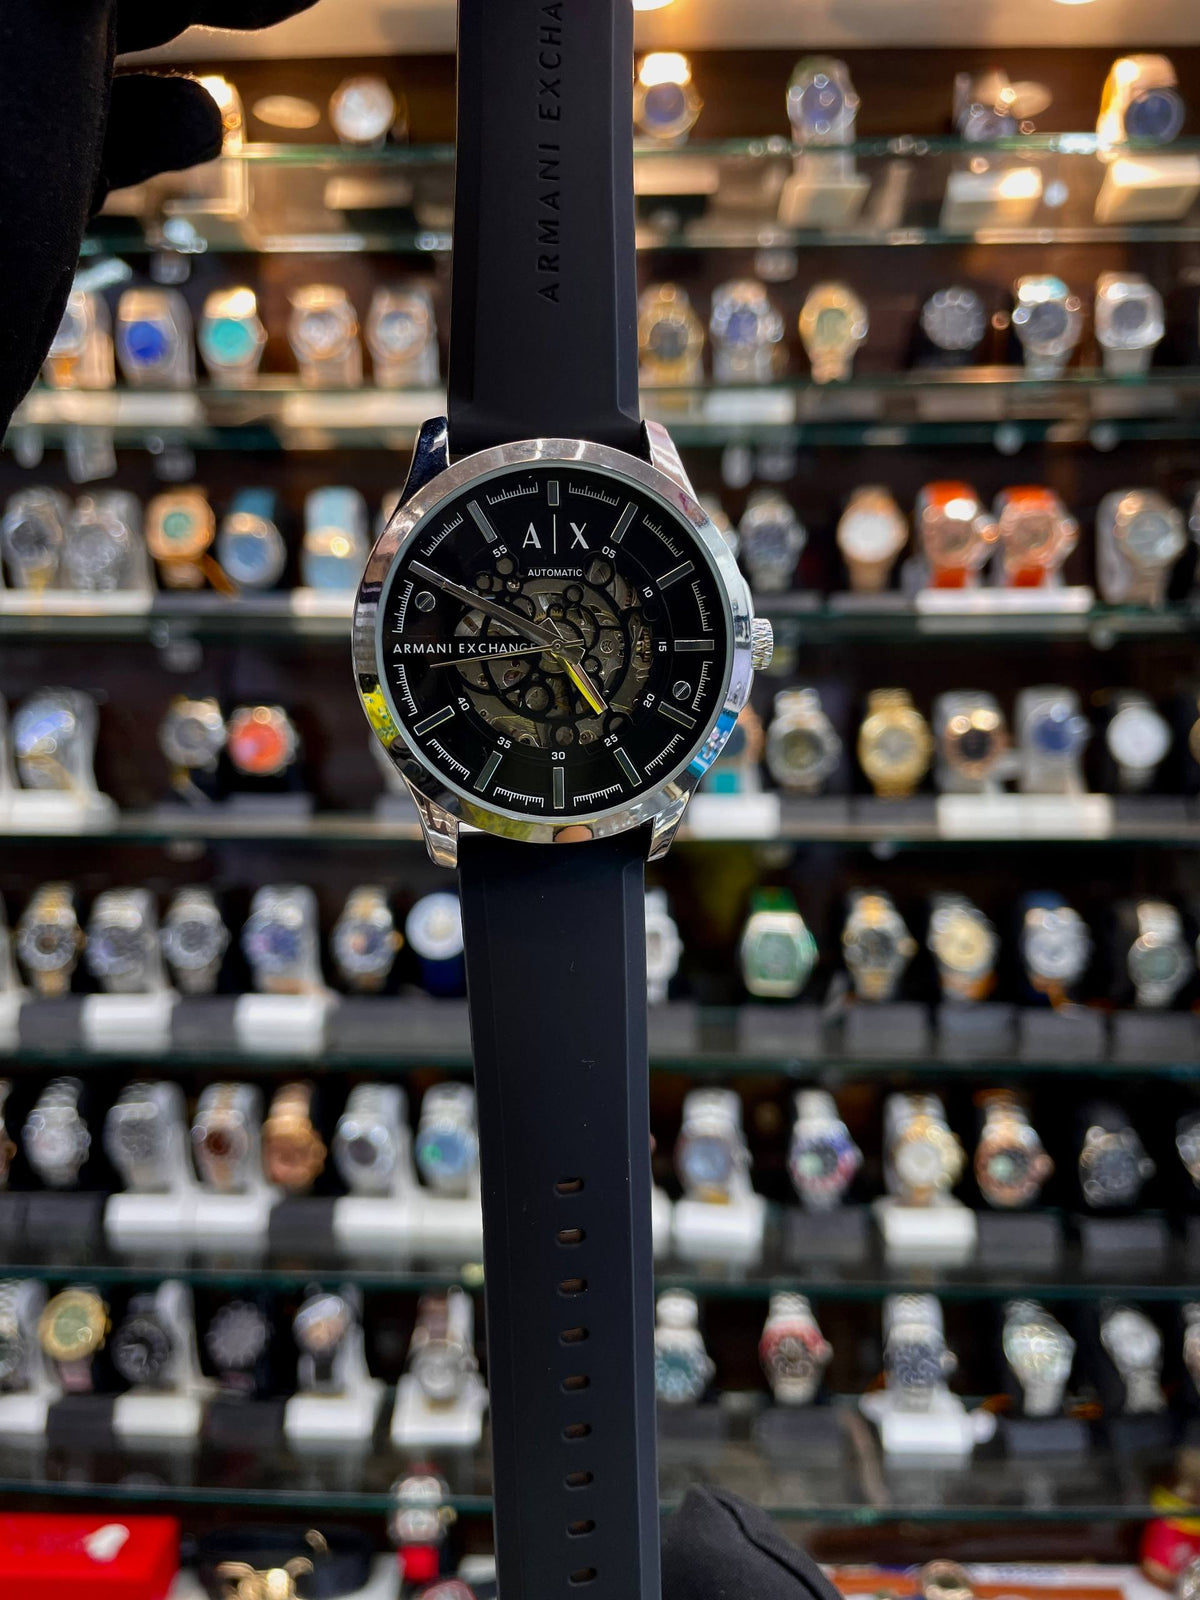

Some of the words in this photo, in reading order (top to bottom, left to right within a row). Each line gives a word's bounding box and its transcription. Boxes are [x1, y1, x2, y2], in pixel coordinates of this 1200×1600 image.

[537, 143, 560, 303] ARMANI
[492, 544, 508, 558] 55
[601, 545, 617, 559] 05
[527, 568, 583, 577] AUTOMATIC
[642, 586, 654, 598] 10
[393, 643, 452, 654] ARMANI
[658, 641, 667, 652] 15
[457, 697, 470, 711] 40
[643, 693, 655, 708] 20
[497, 736, 512, 749] 35
[603, 733, 619, 747] 25
[551, 751, 566, 760] 30
